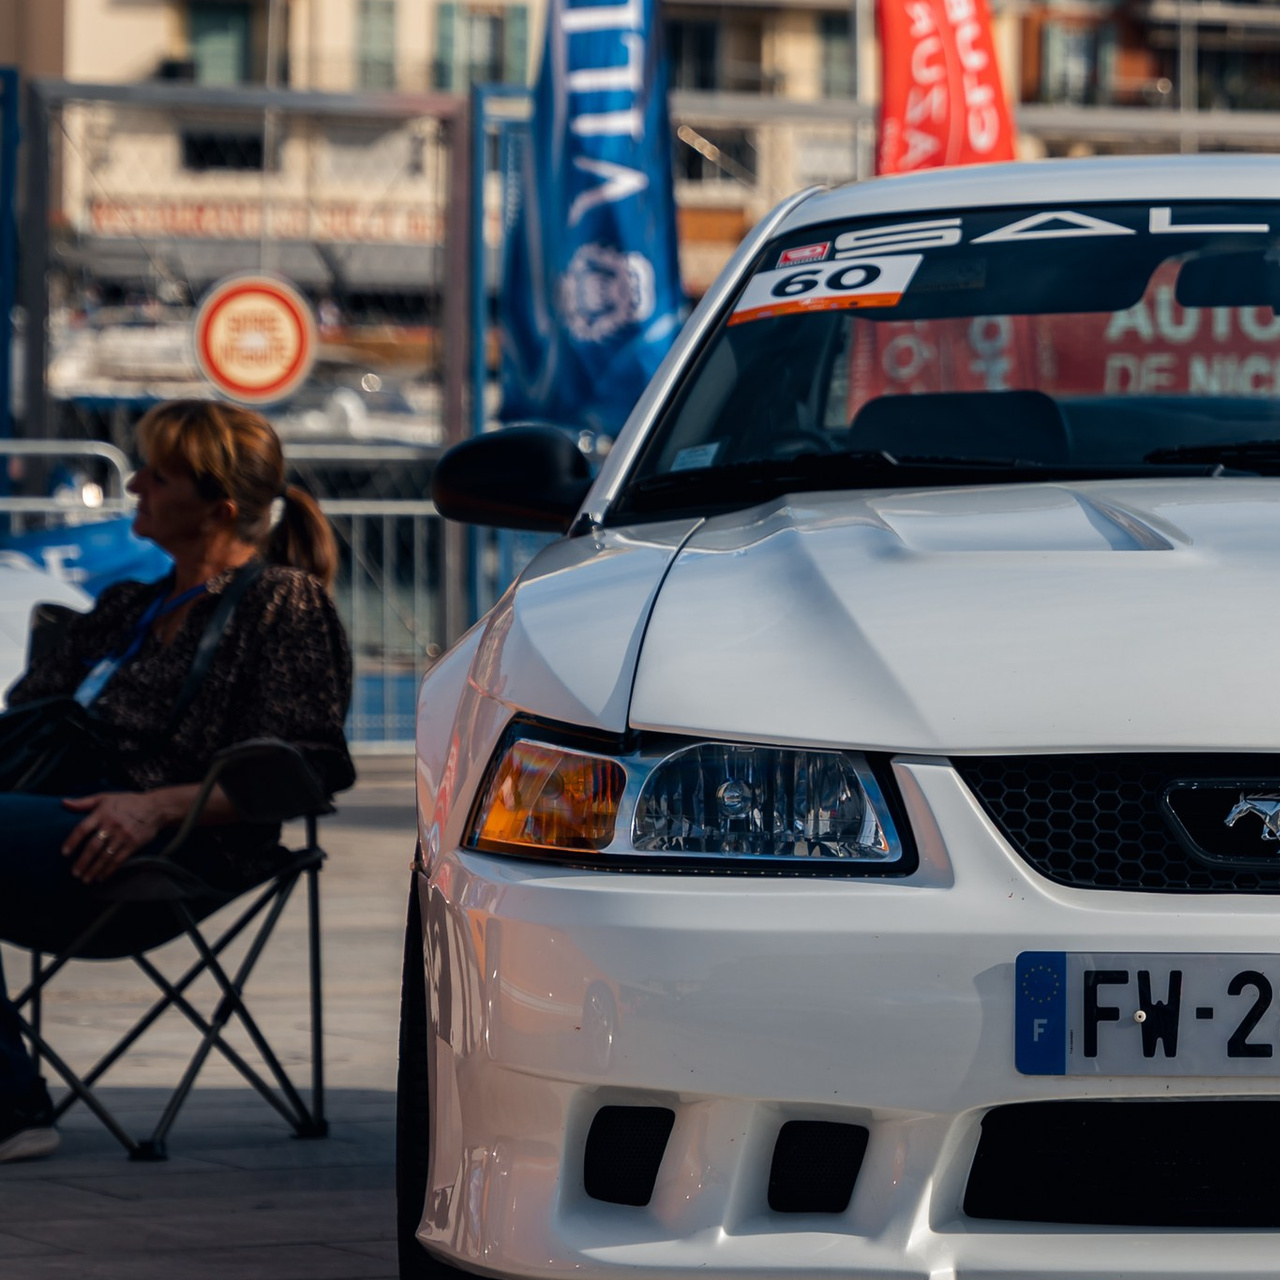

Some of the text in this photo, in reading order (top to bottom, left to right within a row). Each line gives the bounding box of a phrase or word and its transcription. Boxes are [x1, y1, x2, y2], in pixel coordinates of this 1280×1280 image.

[771, 264, 881, 298] 60
[1104, 353, 1177, 395] DE
[1033, 1019, 1048, 1042] F
